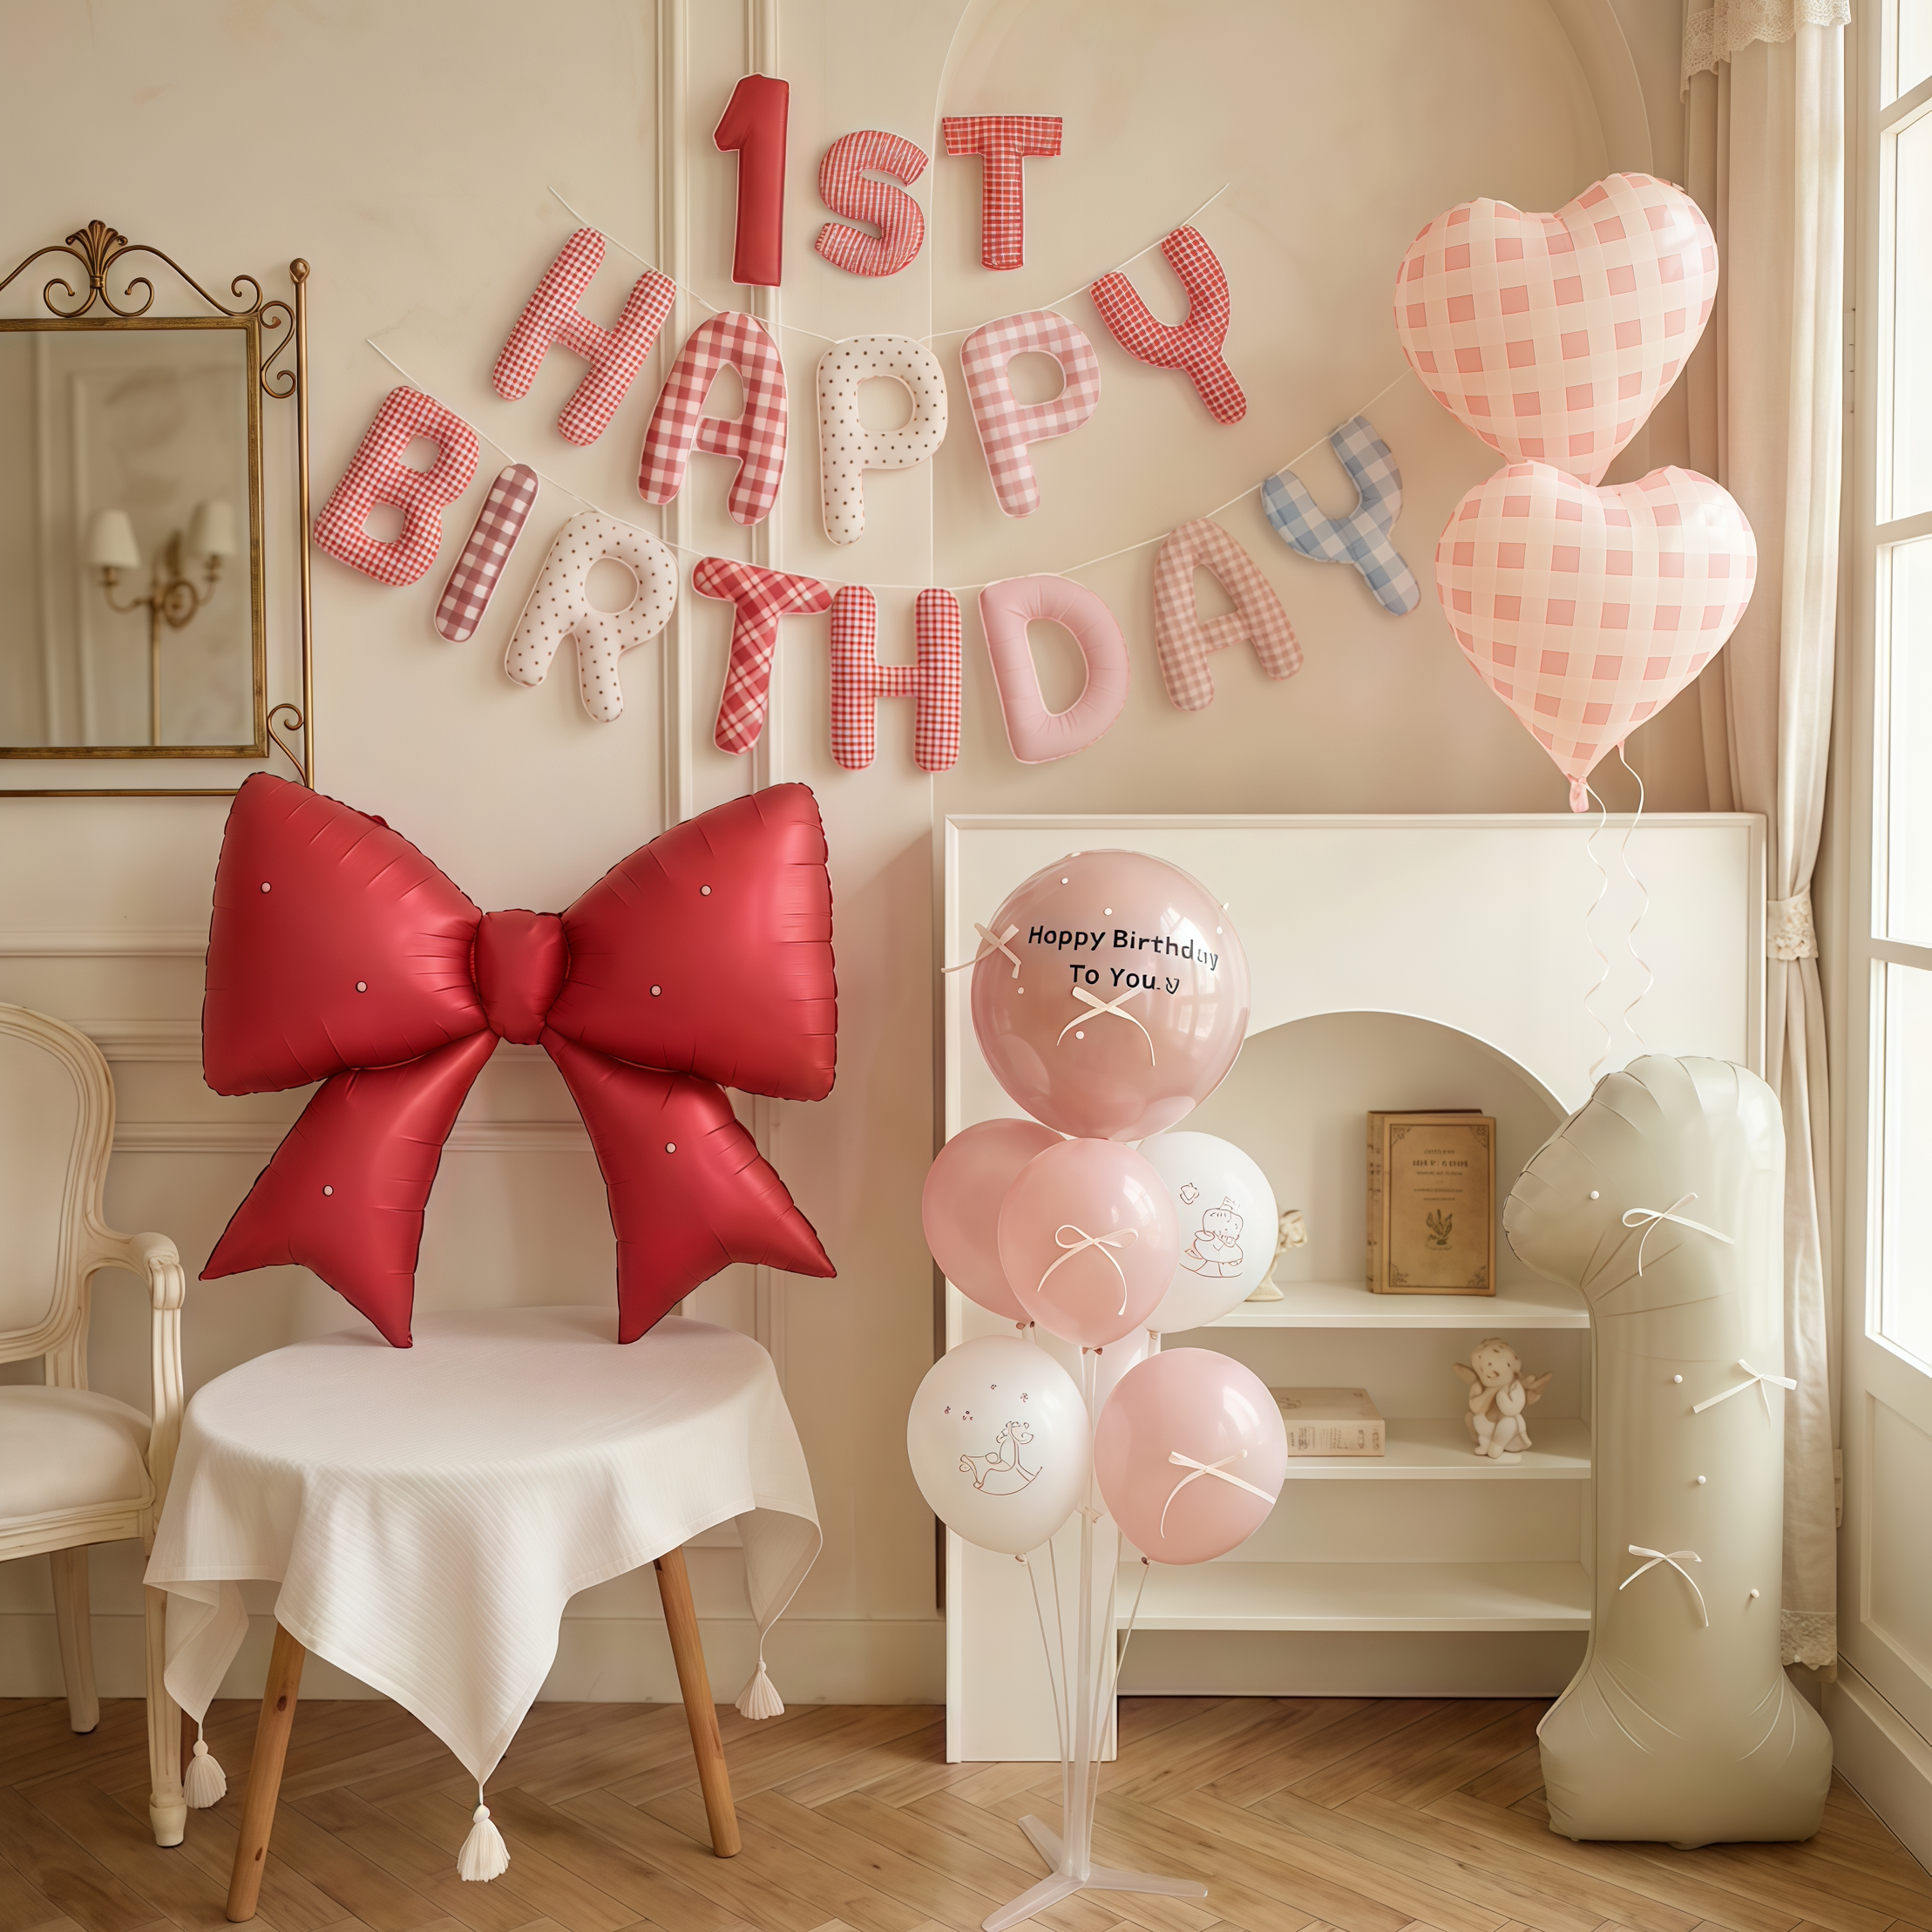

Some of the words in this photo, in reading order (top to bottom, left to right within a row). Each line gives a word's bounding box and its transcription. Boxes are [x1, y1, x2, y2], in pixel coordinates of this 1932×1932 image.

[713, 73, 1063, 287] 1ST
[492, 225, 1248, 546] HAPPY
[315, 385, 1421, 773] BIRTHDAY
[1069, 964, 1100, 985] To
